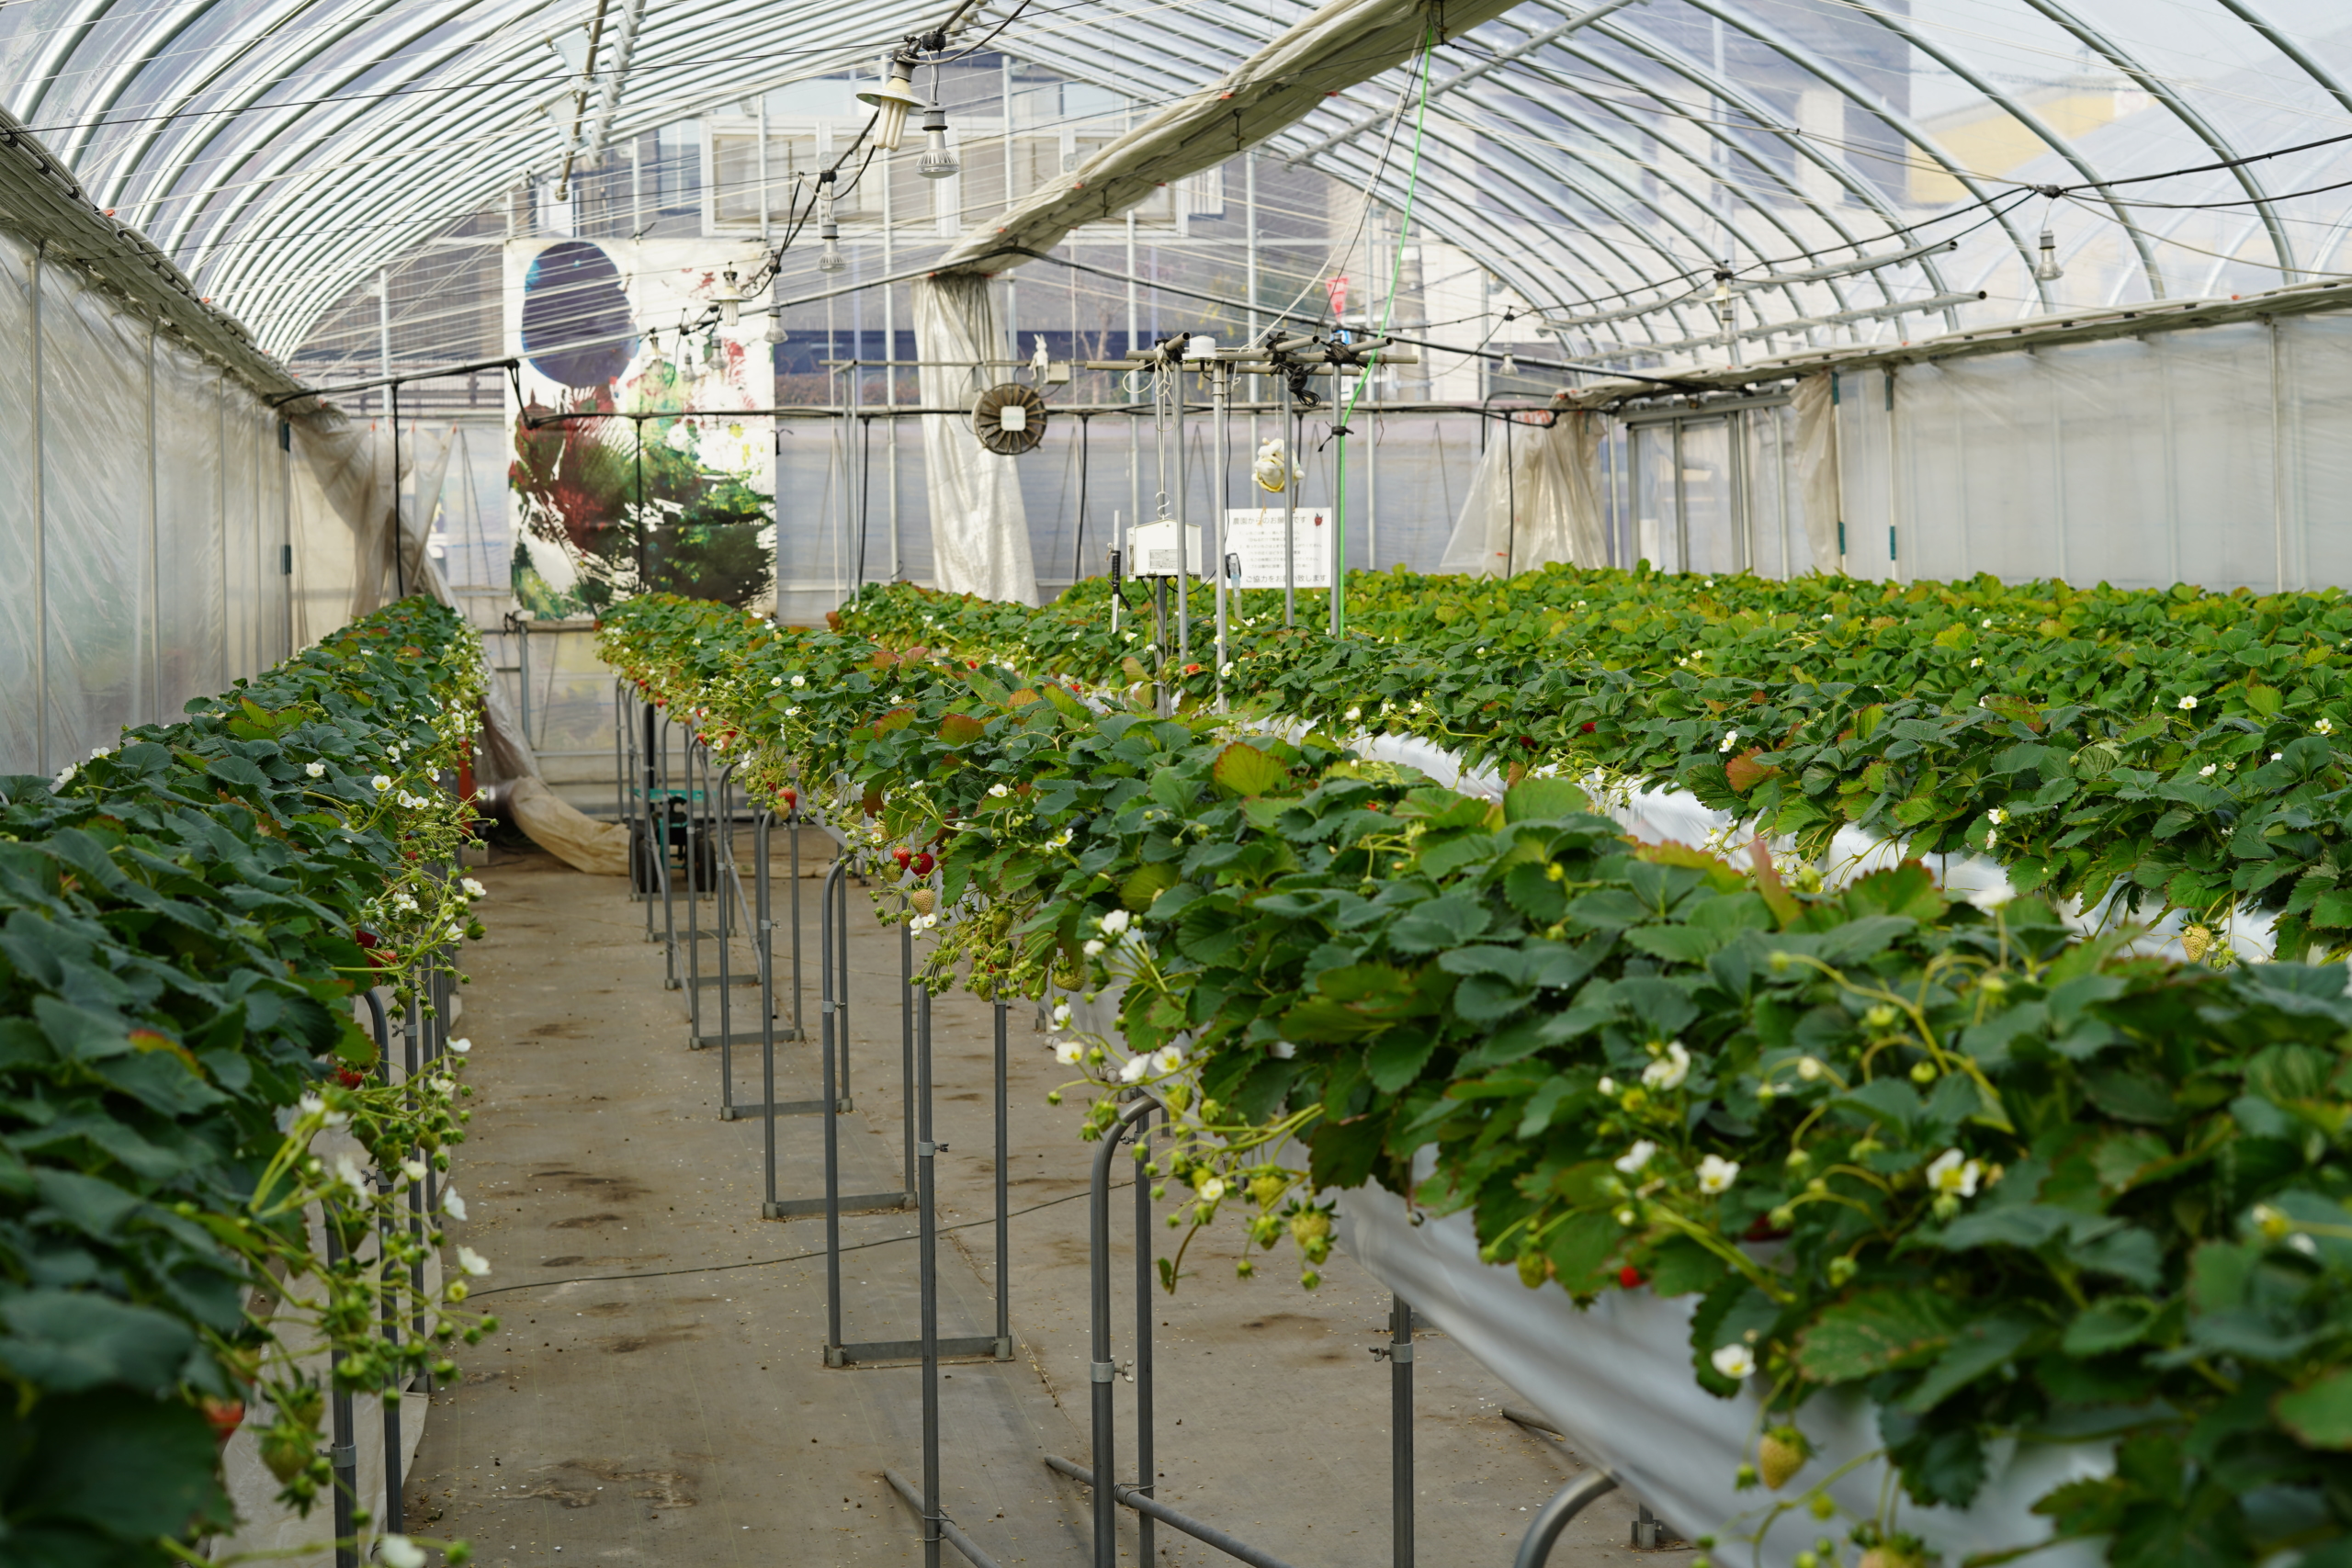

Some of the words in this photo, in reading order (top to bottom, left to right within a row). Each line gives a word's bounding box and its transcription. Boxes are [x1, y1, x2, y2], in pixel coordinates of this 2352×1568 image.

[1232, 516, 1306, 525] 農園からのお願です
